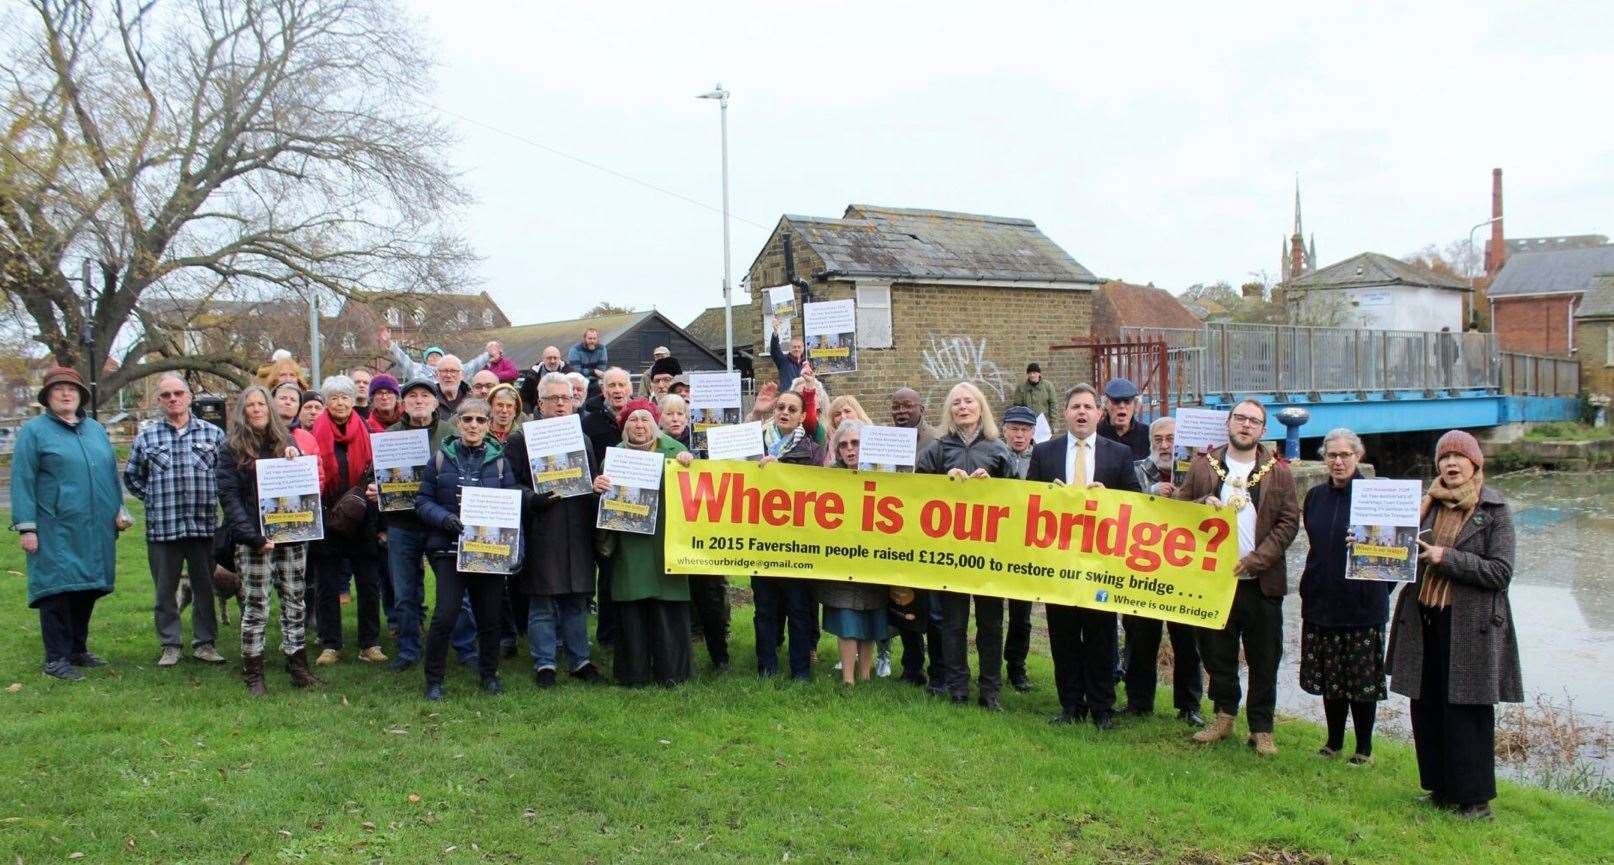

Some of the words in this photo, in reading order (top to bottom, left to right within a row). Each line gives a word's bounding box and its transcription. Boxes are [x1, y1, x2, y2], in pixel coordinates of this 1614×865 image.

[677, 471, 845, 529] Where
[862, 481, 904, 534] is
[920, 499, 1010, 543] our
[1024, 494, 1231, 573] bridge?
[677, 556, 814, 570] wheresourbridge@gmail.com
[692, 536, 704, 549] In
[709, 537, 744, 550] 2015
[748, 537, 820, 555] Faversham
[825, 544, 869, 559] people
[873, 547, 914, 562] raised
[919, 550, 985, 570] £125,000
[990, 557, 1003, 571] to
[1007, 562, 1055, 578] restore
[1059, 568, 1082, 580] our
[1085, 570, 1125, 589] swing
[1129, 574, 1175, 596] bridge
[1113, 594, 1147, 608] Where
[1148, 599, 1157, 610] is
[1159, 602, 1177, 613] our
[1179, 604, 1220, 620] Bridge?
